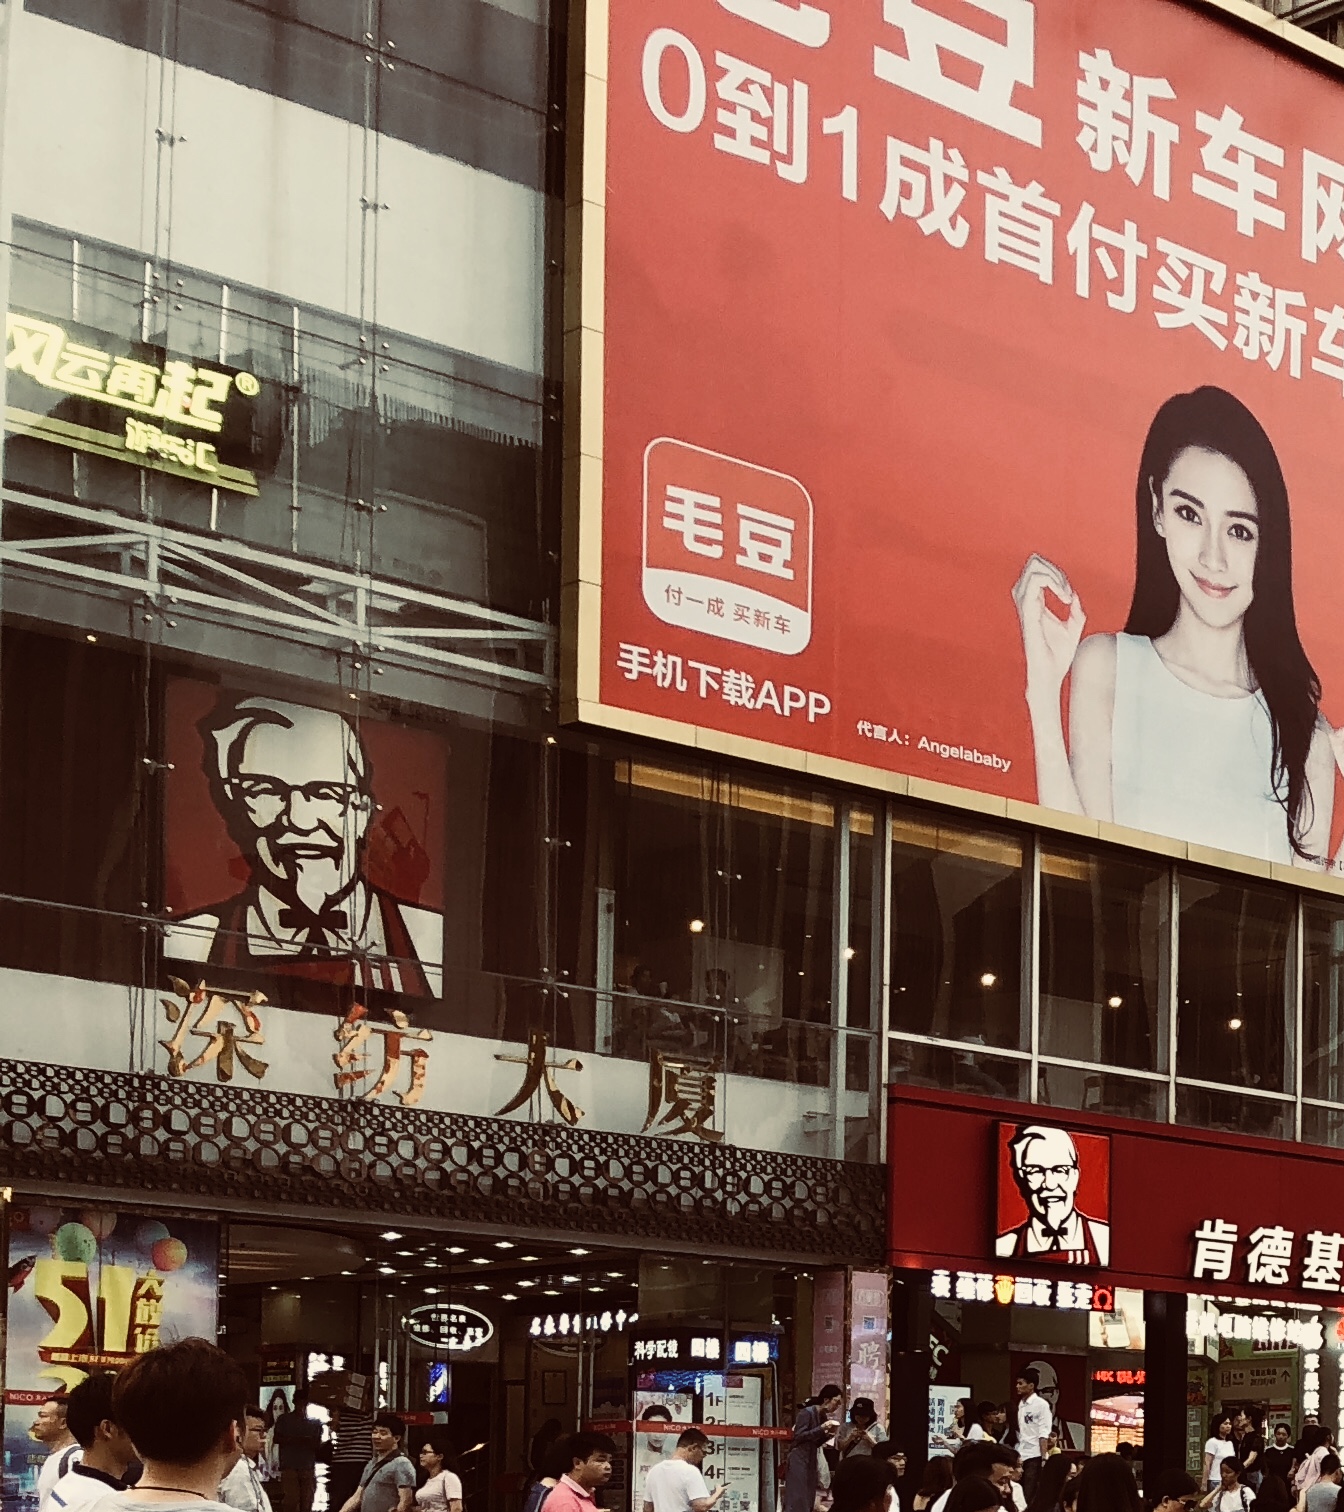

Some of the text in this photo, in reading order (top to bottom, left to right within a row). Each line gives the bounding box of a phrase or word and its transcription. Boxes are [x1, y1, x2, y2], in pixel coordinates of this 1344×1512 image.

[663, 484, 796, 581] 毛豆
[664, 584, 791, 635] 付一成 买新车
[616, 642, 831, 723] 手机下载APP
[917, 735, 1012, 773] Angelababy
[158, 974, 724, 1143] 深纺大厦
[705, 1392, 724, 1407] 1F
[704, 1464, 724, 1480] 4F
